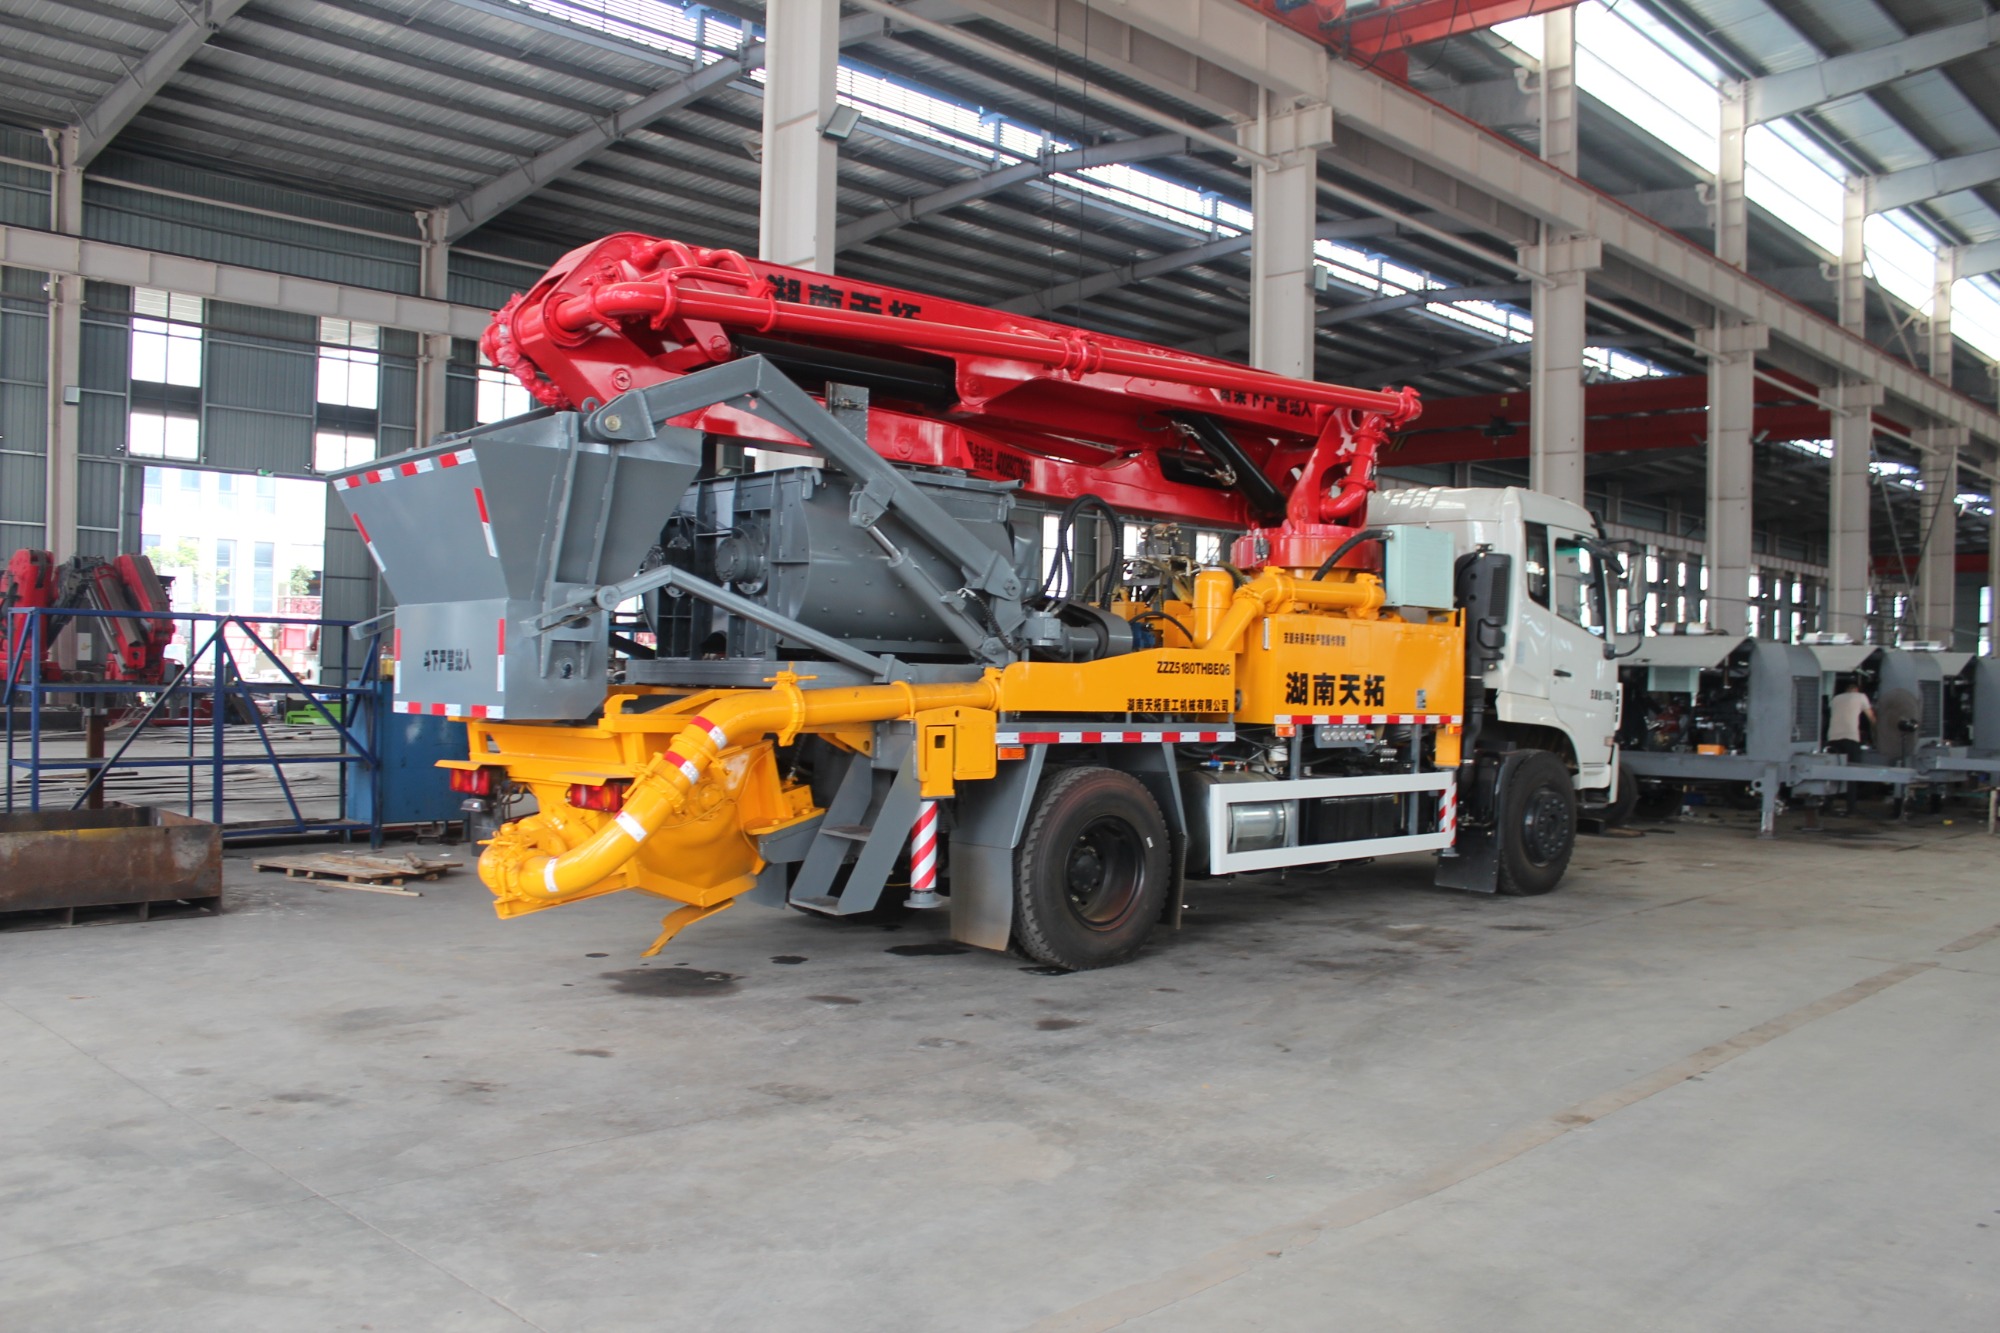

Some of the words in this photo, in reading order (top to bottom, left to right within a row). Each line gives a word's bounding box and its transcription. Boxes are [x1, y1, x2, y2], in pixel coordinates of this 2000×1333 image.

[1285, 672, 1385, 707] 湖南天拓
[1127, 698, 1229, 712] 湖南天拓重工机械有限公司
